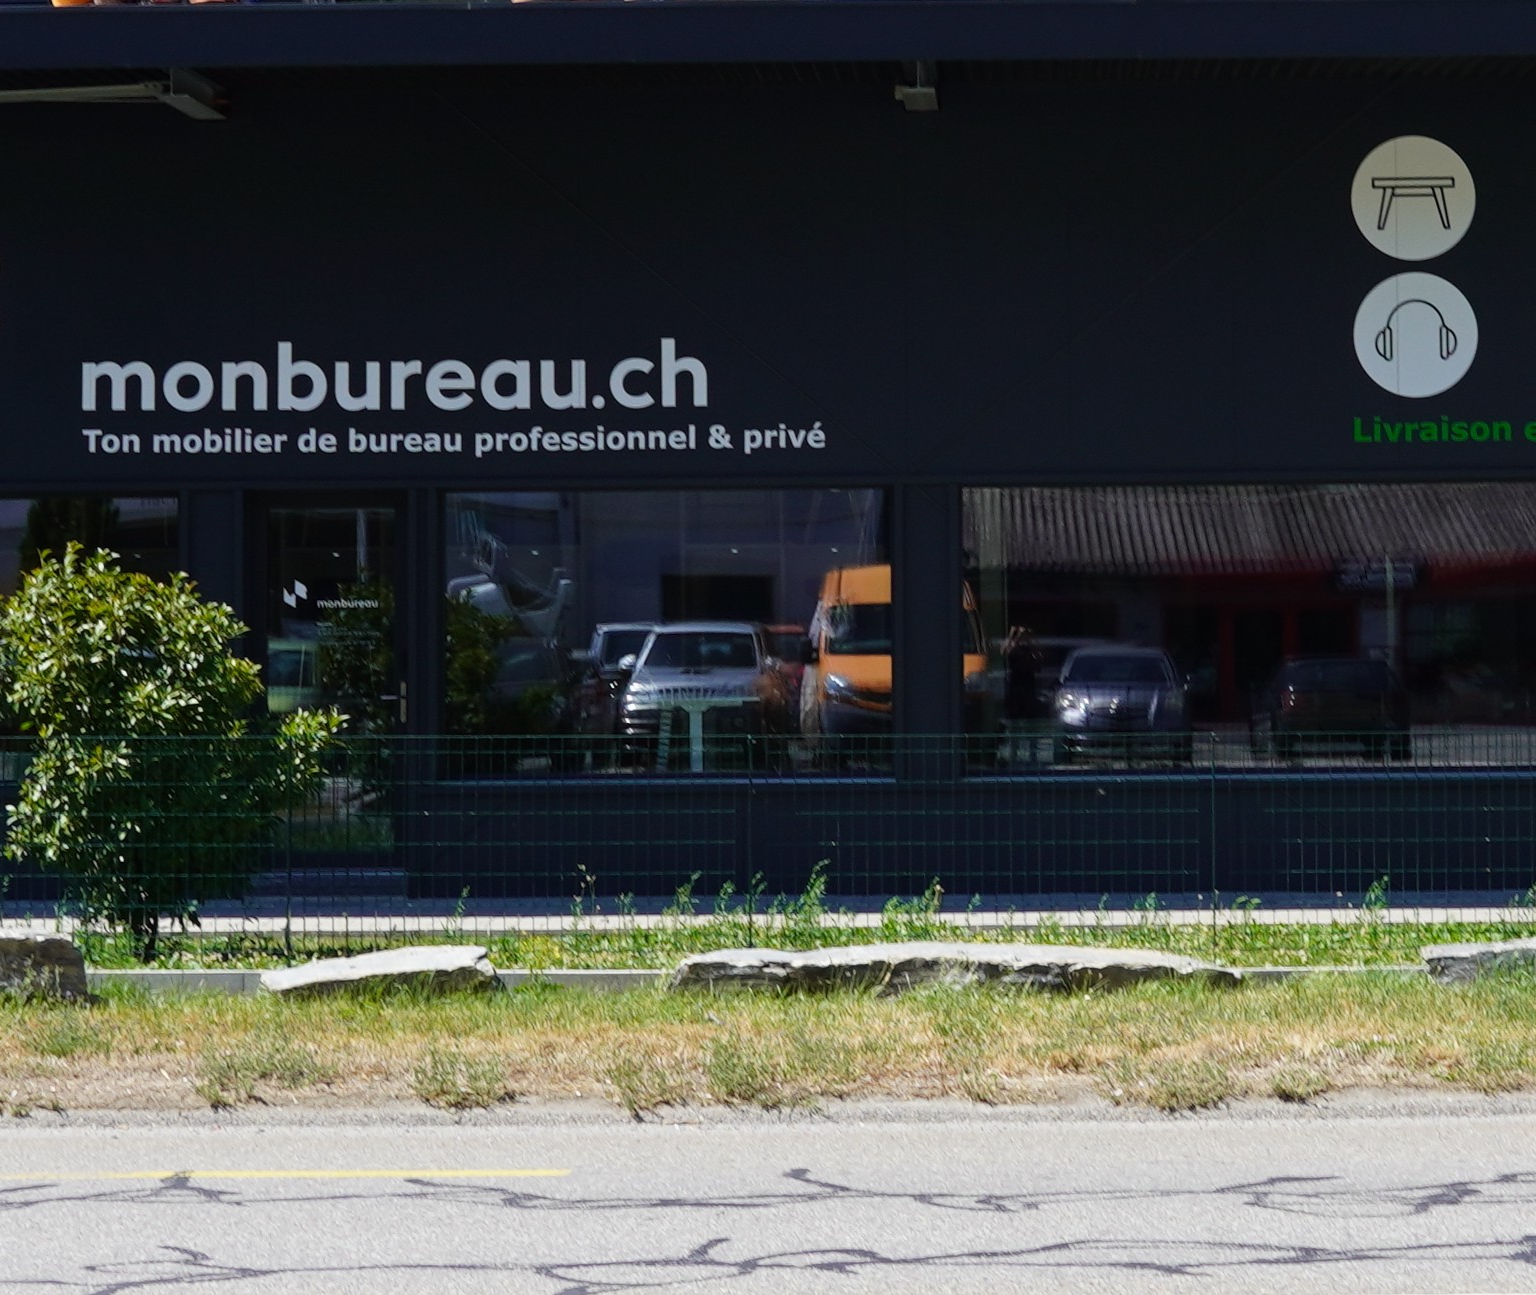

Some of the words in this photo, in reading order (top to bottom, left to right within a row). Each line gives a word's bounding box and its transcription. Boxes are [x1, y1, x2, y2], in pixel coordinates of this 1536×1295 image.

[81, 337, 709, 413] monbureau.ch
[81, 428, 141, 454] Ton
[152, 427, 288, 454] mobilier
[297, 426, 338, 453] de
[348, 426, 463, 453] bureau
[474, 423, 696, 458] professionnel
[707, 423, 734, 450] &
[743, 421, 827, 455] privé
[1351, 415, 1514, 444] Livraison
[316, 597, 379, 609] monbureau
